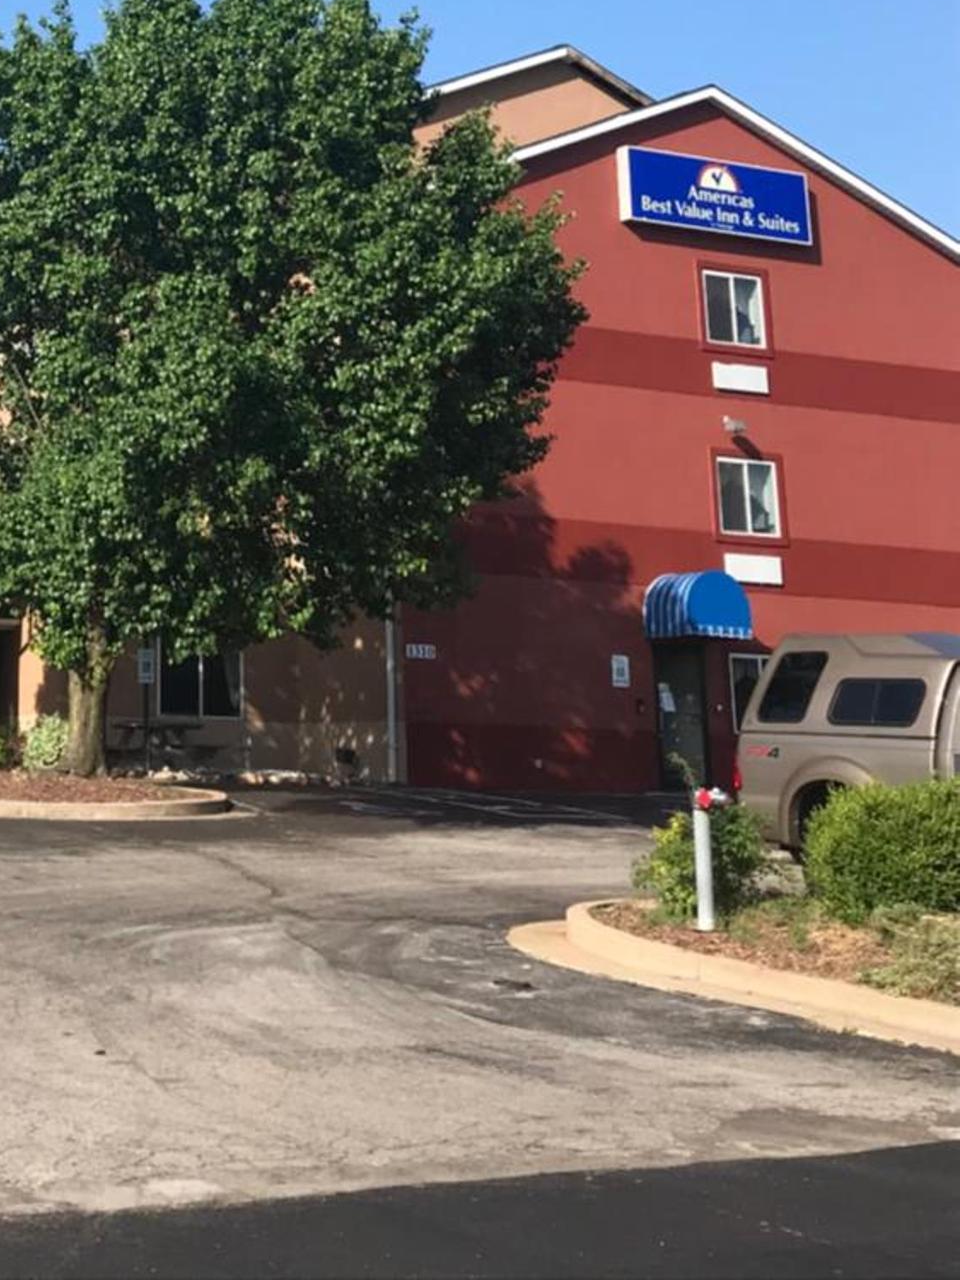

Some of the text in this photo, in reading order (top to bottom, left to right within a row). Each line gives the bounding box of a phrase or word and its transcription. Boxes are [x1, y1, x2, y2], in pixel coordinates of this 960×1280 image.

[687, 185, 755, 208] Americas
[641, 195, 672, 213] Best
[675, 201, 713, 221] Value
[716, 206, 739, 225] Inn
[742, 212, 754, 227] &
[758, 214, 800, 235] Suites
